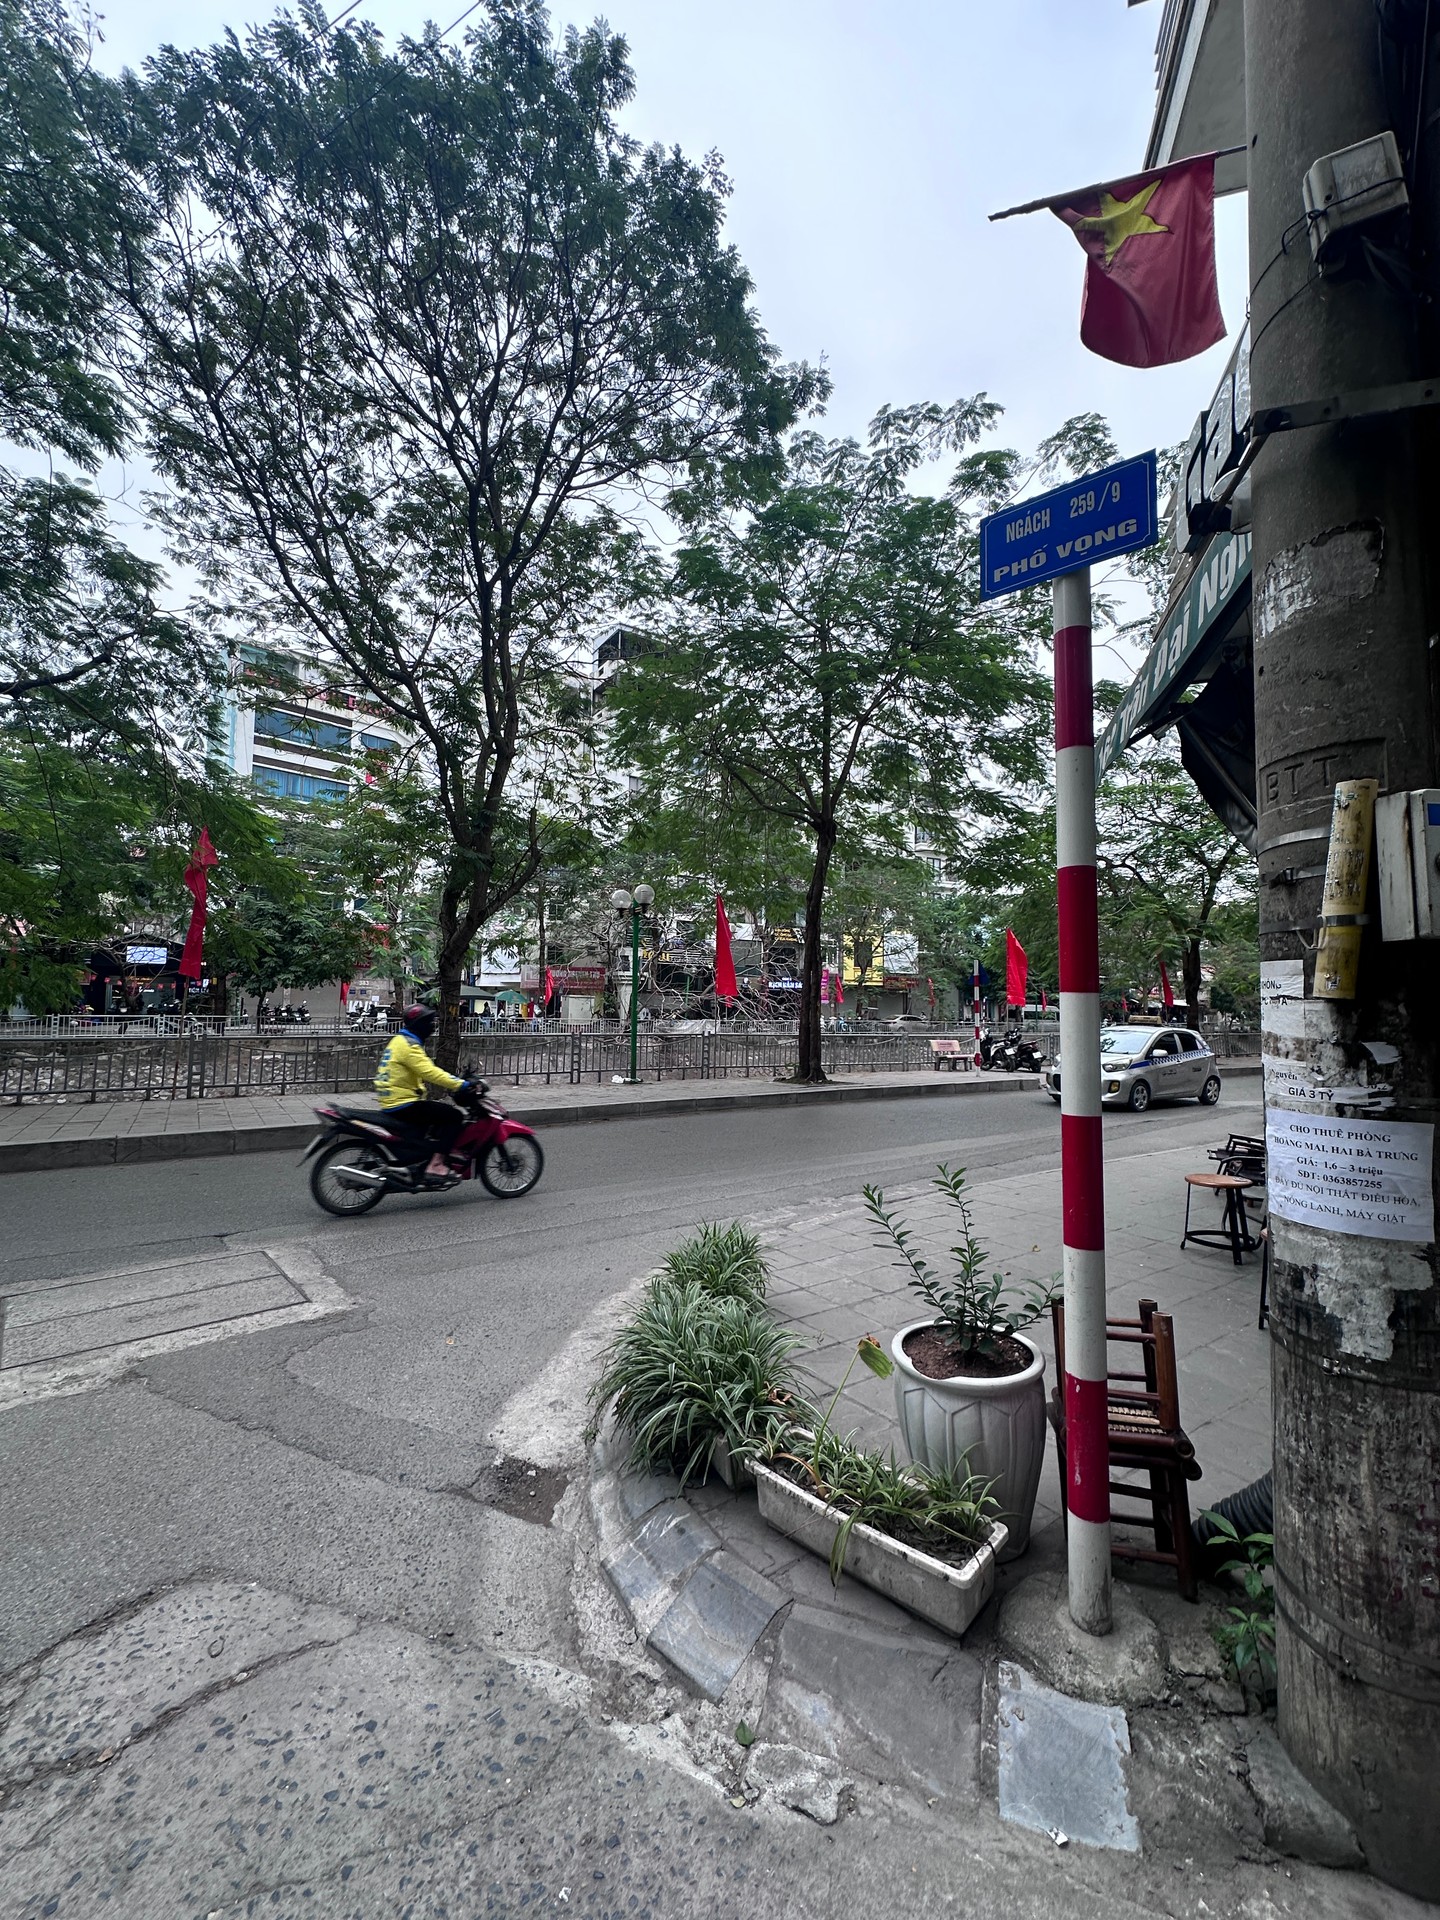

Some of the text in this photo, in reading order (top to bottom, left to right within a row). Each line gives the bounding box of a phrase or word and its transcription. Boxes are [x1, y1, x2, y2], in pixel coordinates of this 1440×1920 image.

[1006, 507, 1051, 544] NGÁCH
[993, 518, 1137, 583] PHỐ VỌNG
[1153, 600, 1191, 691] Đại
[1288, 1086, 1334, 1101] GIÁ 3 TỶ
[1289, 1124, 1391, 1143] CHO THUÊ PHÒNG
[1274, 1135, 1302, 1149] HOÀNG
[1331, 1145, 1353, 1156] HAI
[1356, 1147, 1373, 1158] BÀ
[1376, 1150, 1418, 1161] TRƯNG
[1296, 1156, 1318, 1167] GIÁ:
[1324, 1161, 1338, 1170] 1,6
[1349, 1164, 1356, 1173] 3
[1358, 1166, 1383, 1177] triệu
[1297, 1169, 1382, 1189] SĐT: 0363857255
[1291, 1180, 1303, 1190] ĐỦ
[1306, 1183, 1324, 1195] NỘI
[1326, 1187, 1358, 1200] THẤT
[1361, 1192, 1390, 1204] ĐIỀU
[1284, 1194, 1407, 1225] NÓNG LẠNH, MÁY GIẶT
